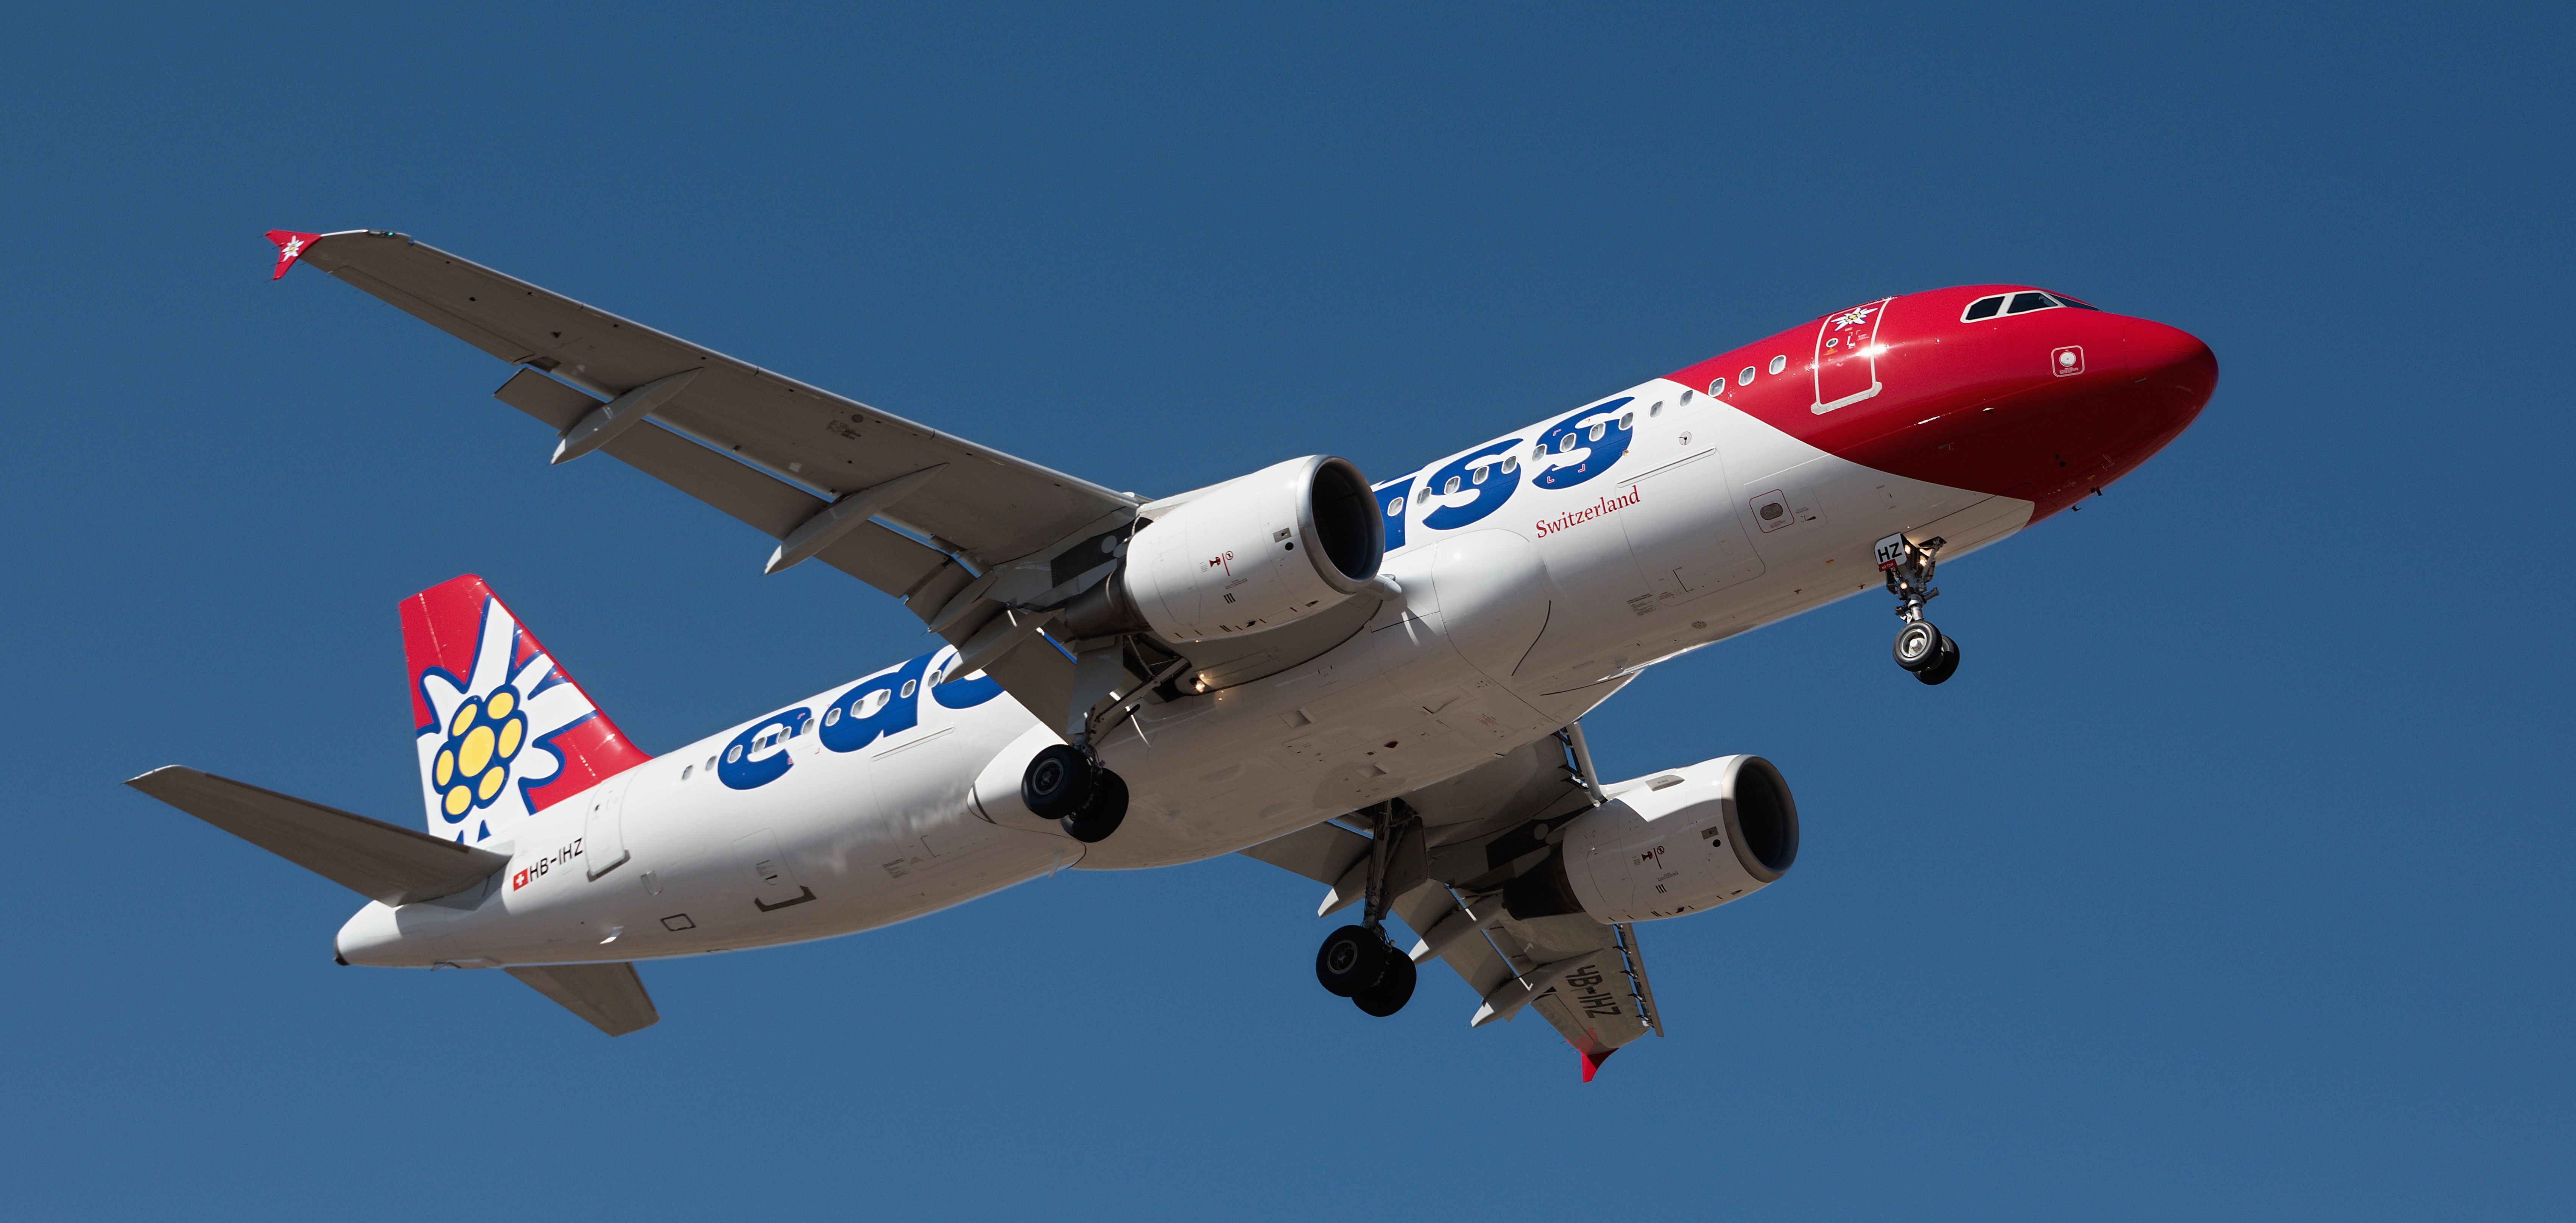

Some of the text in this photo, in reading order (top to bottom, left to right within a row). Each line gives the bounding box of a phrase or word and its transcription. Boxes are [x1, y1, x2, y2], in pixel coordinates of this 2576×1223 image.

[1535, 485, 1640, 538] Switzerland
[1877, 542, 1902, 562] HZ
[530, 837, 583, 882] HB-IHZ
[1565, 964, 1621, 1018] HB-IHZ
